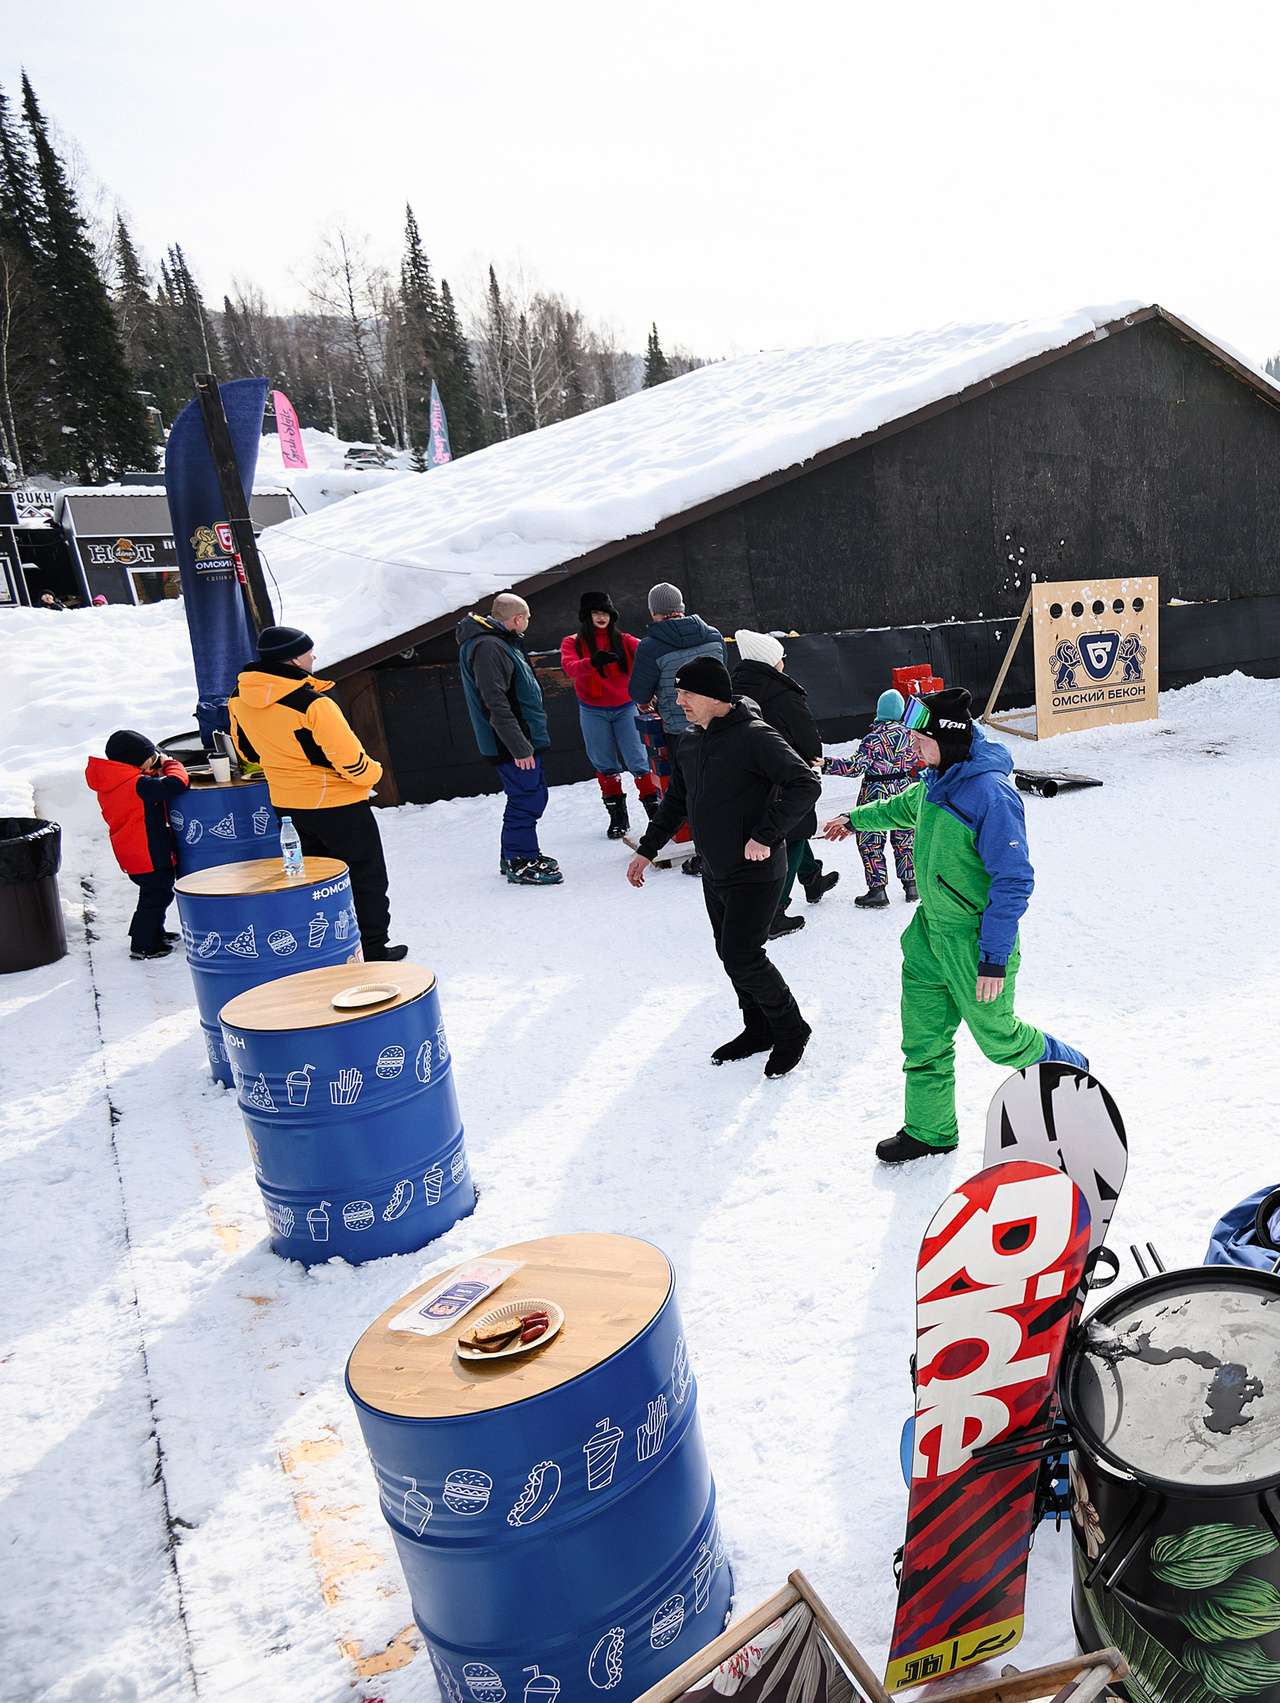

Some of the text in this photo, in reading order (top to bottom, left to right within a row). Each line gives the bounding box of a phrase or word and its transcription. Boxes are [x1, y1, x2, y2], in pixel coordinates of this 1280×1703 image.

[1052, 686, 1145, 707] ОМСКИЙ БЕКОН
[913, 1172, 1074, 1479] Ride
